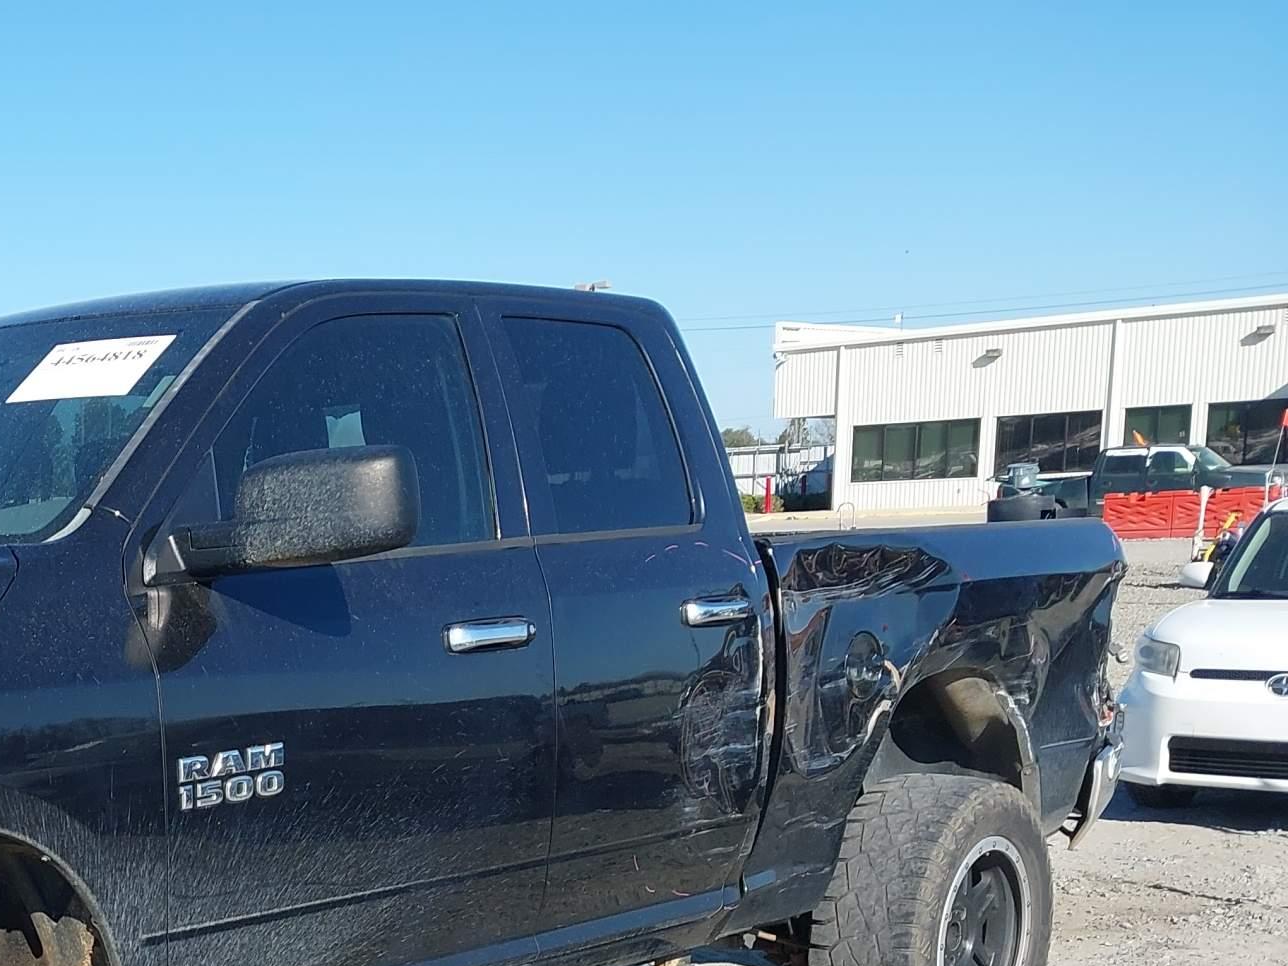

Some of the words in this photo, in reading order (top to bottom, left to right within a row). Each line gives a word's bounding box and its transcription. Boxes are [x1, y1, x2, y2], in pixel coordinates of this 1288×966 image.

[50, 349, 148, 367] 44564818
[177, 742, 285, 783] RAM
[179, 770, 285, 811] 1500
